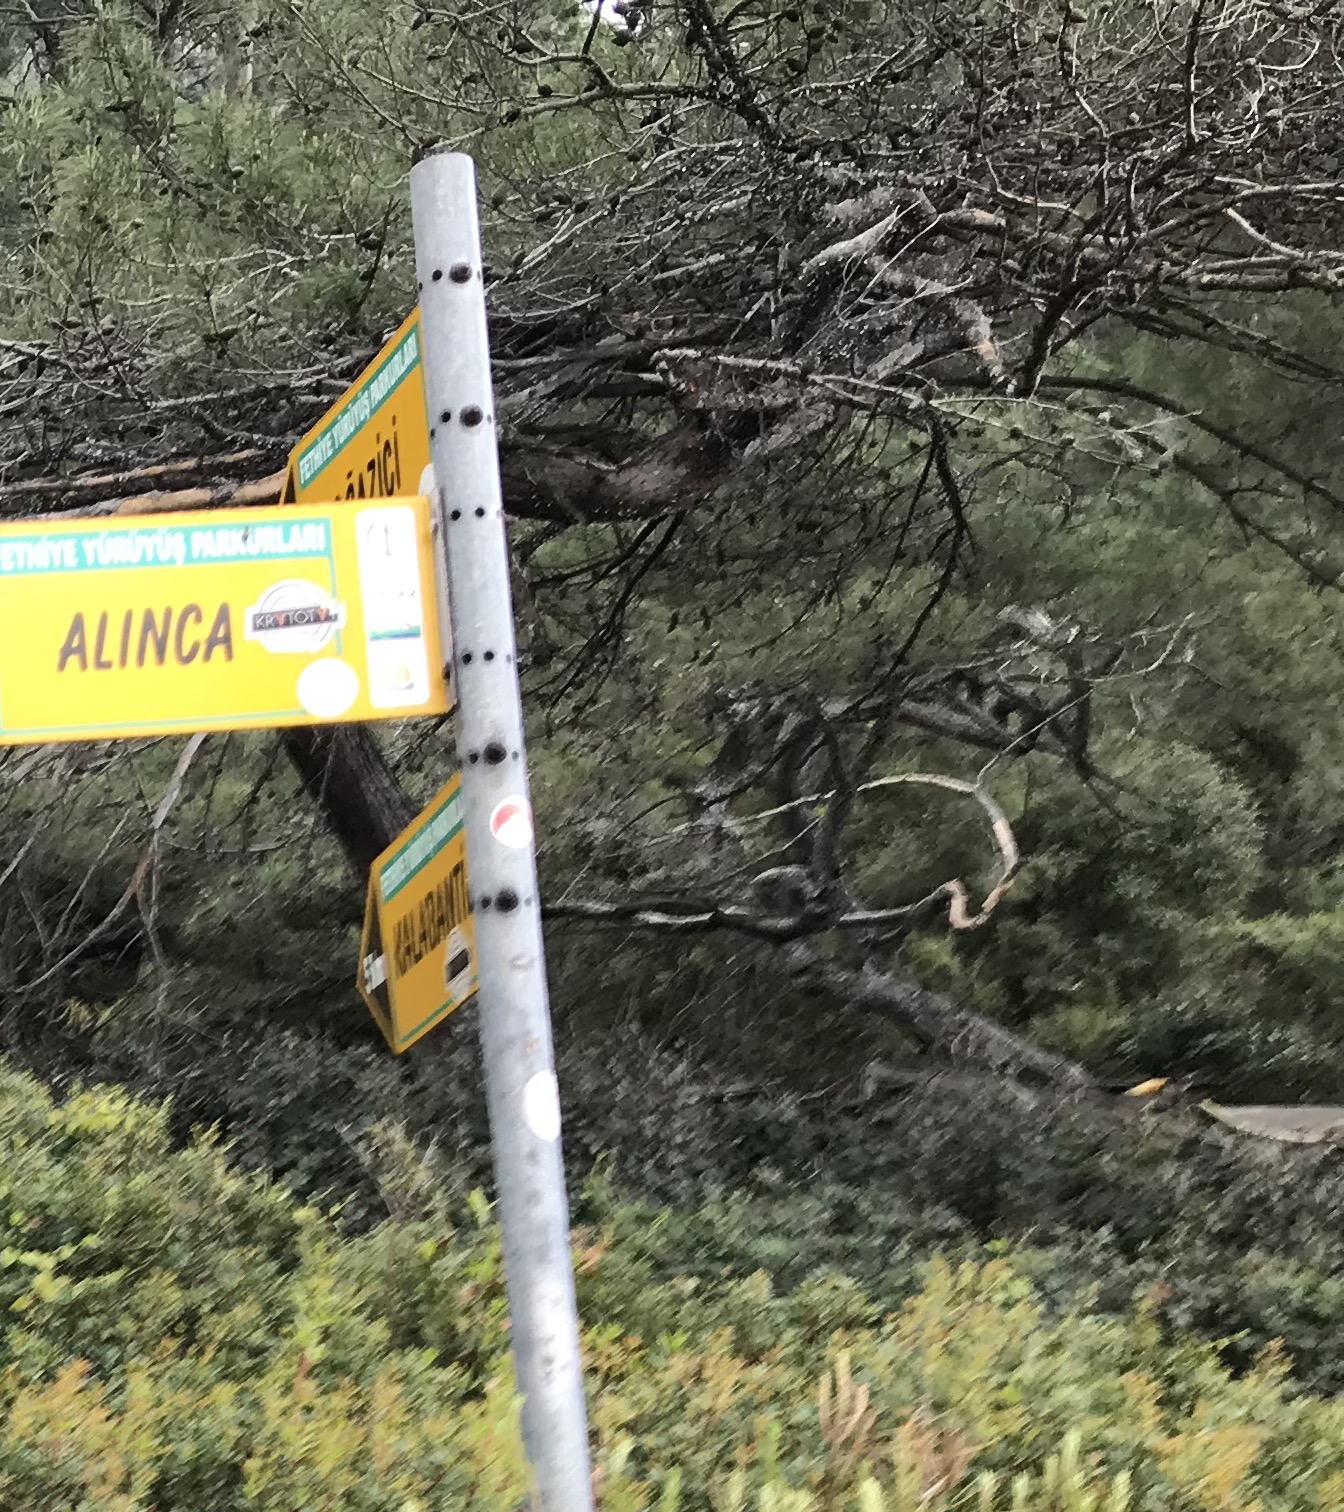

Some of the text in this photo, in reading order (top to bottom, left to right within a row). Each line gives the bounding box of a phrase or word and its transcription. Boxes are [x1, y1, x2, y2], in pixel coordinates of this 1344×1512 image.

[81, 527, 187, 565] YÜRÜYÜŞ
[190, 522, 327, 559] PARKURLARI
[56, 600, 235, 674] ALINCA
